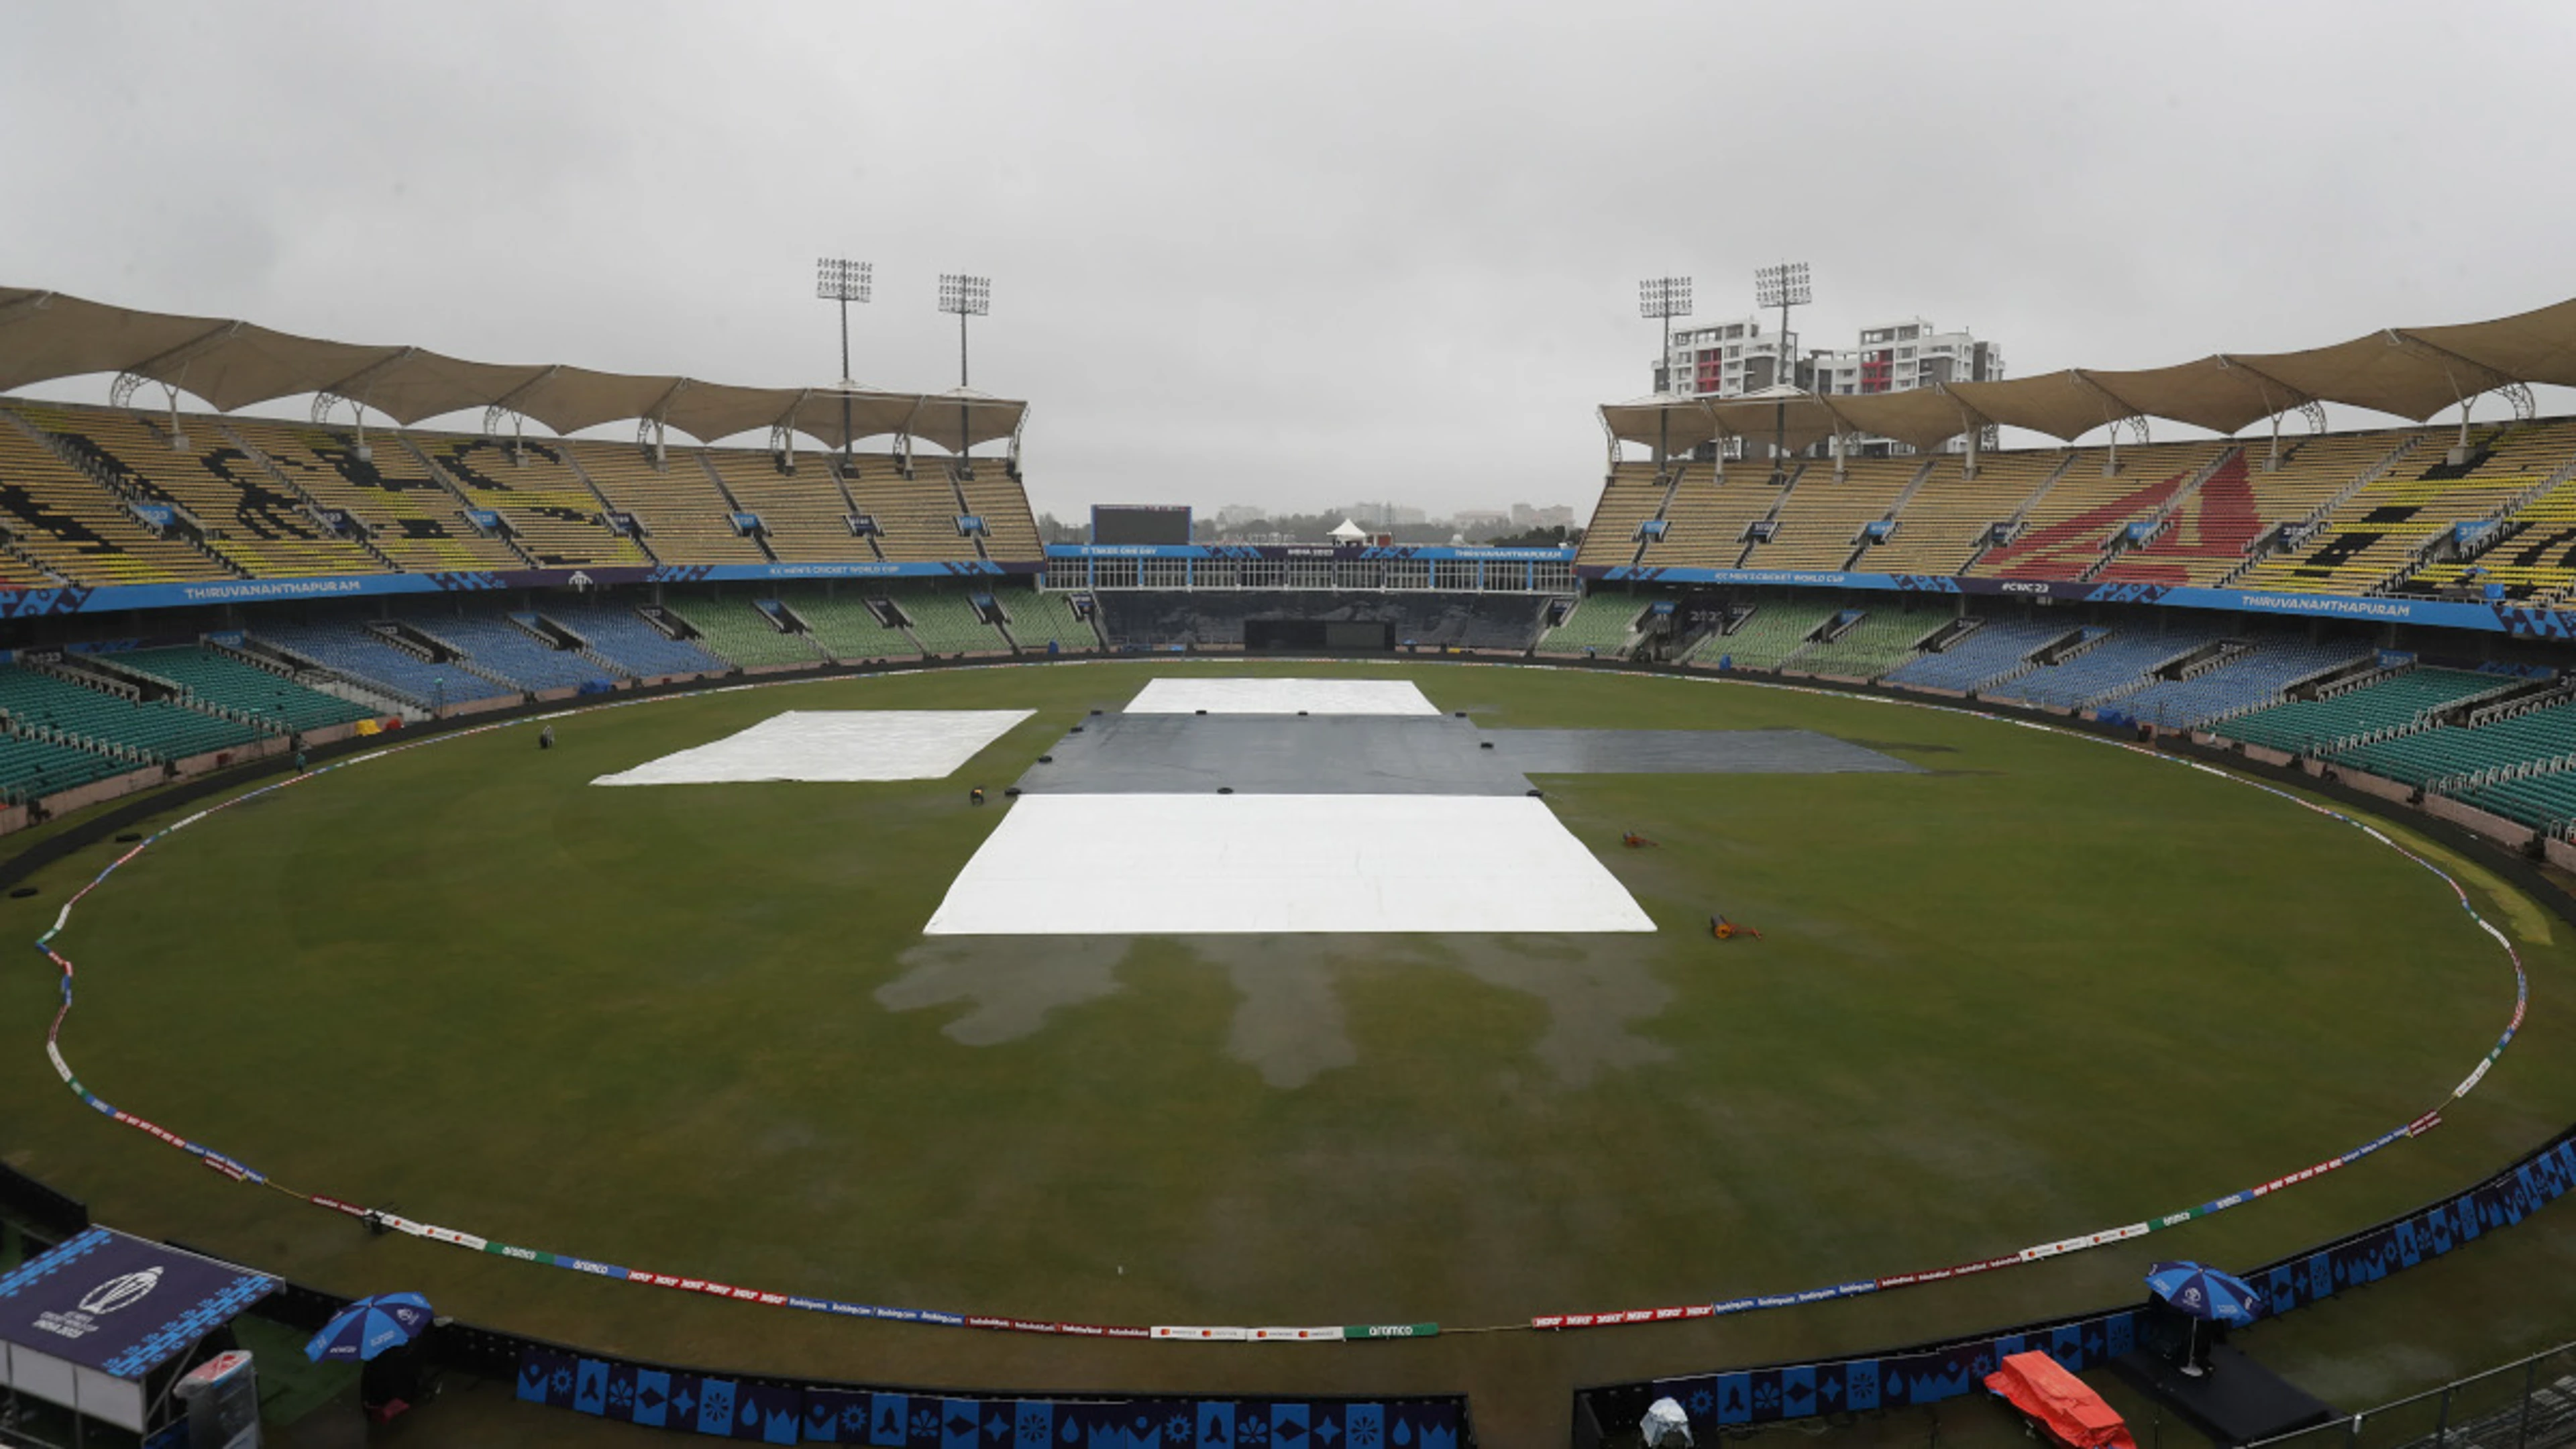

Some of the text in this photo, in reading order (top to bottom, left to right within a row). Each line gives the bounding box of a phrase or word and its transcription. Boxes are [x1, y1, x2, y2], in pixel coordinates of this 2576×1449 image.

[184, 580, 361, 600] THIRUVANANTHAPURAM
[2241, 596, 2412, 616] THIRUVANANTHAPURAM
[1368, 1325, 1413, 1336] aramco
